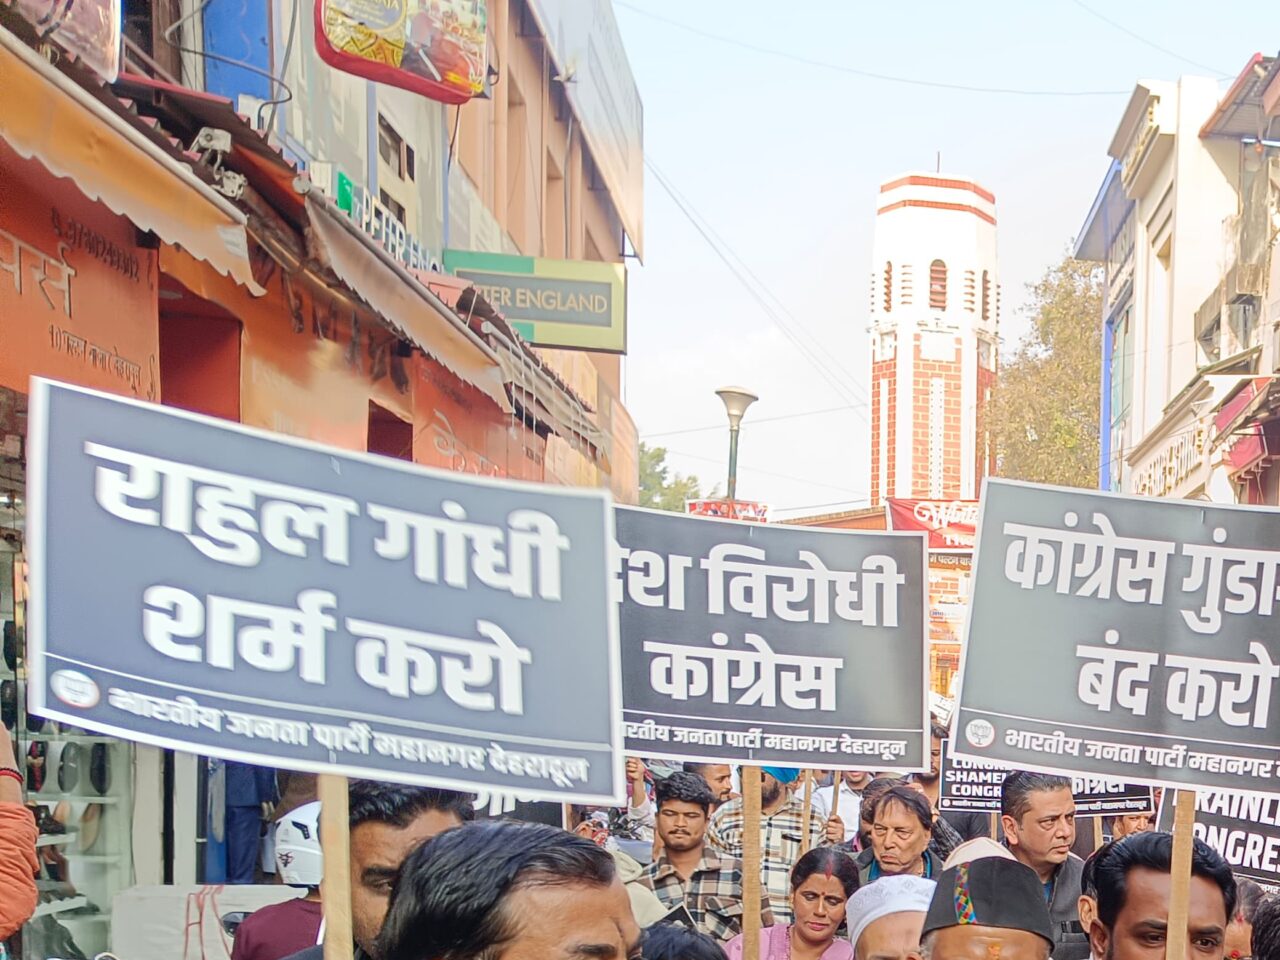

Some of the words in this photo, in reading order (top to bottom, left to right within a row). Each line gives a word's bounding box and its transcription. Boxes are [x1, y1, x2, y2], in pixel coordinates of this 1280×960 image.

[516, 288, 608, 314] ENGLAND
[84, 441, 360, 567] राहुल
[367, 501, 571, 600] गांधी
[1002, 511, 1176, 606] कांग्रेस
[700, 542, 905, 628] विरोधी
[142, 584, 338, 686] शर्म
[346, 619, 532, 716] करो
[643, 631, 844, 712] कांग्रेस
[1075, 629, 1160, 717] बंद
[1165, 641, 1280, 730] करो
[107, 687, 223, 734] भारतीय
[225, 710, 310, 747] जनता
[314, 717, 372, 755] पार्टी
[372, 734, 485, 771] महानगर
[488, 742, 591, 787] देहरादून
[672, 729, 724, 747] जनता
[725, 727, 764, 751] पार्टी
[764, 733, 840, 755] महानगर
[840, 732, 907, 761] देहरादून
[1004, 728, 1080, 758] भारतीय
[1085, 741, 1143, 765] जनता
[1145, 743, 1187, 769] पार्टी
[1188, 752, 1273, 778] महानगर
